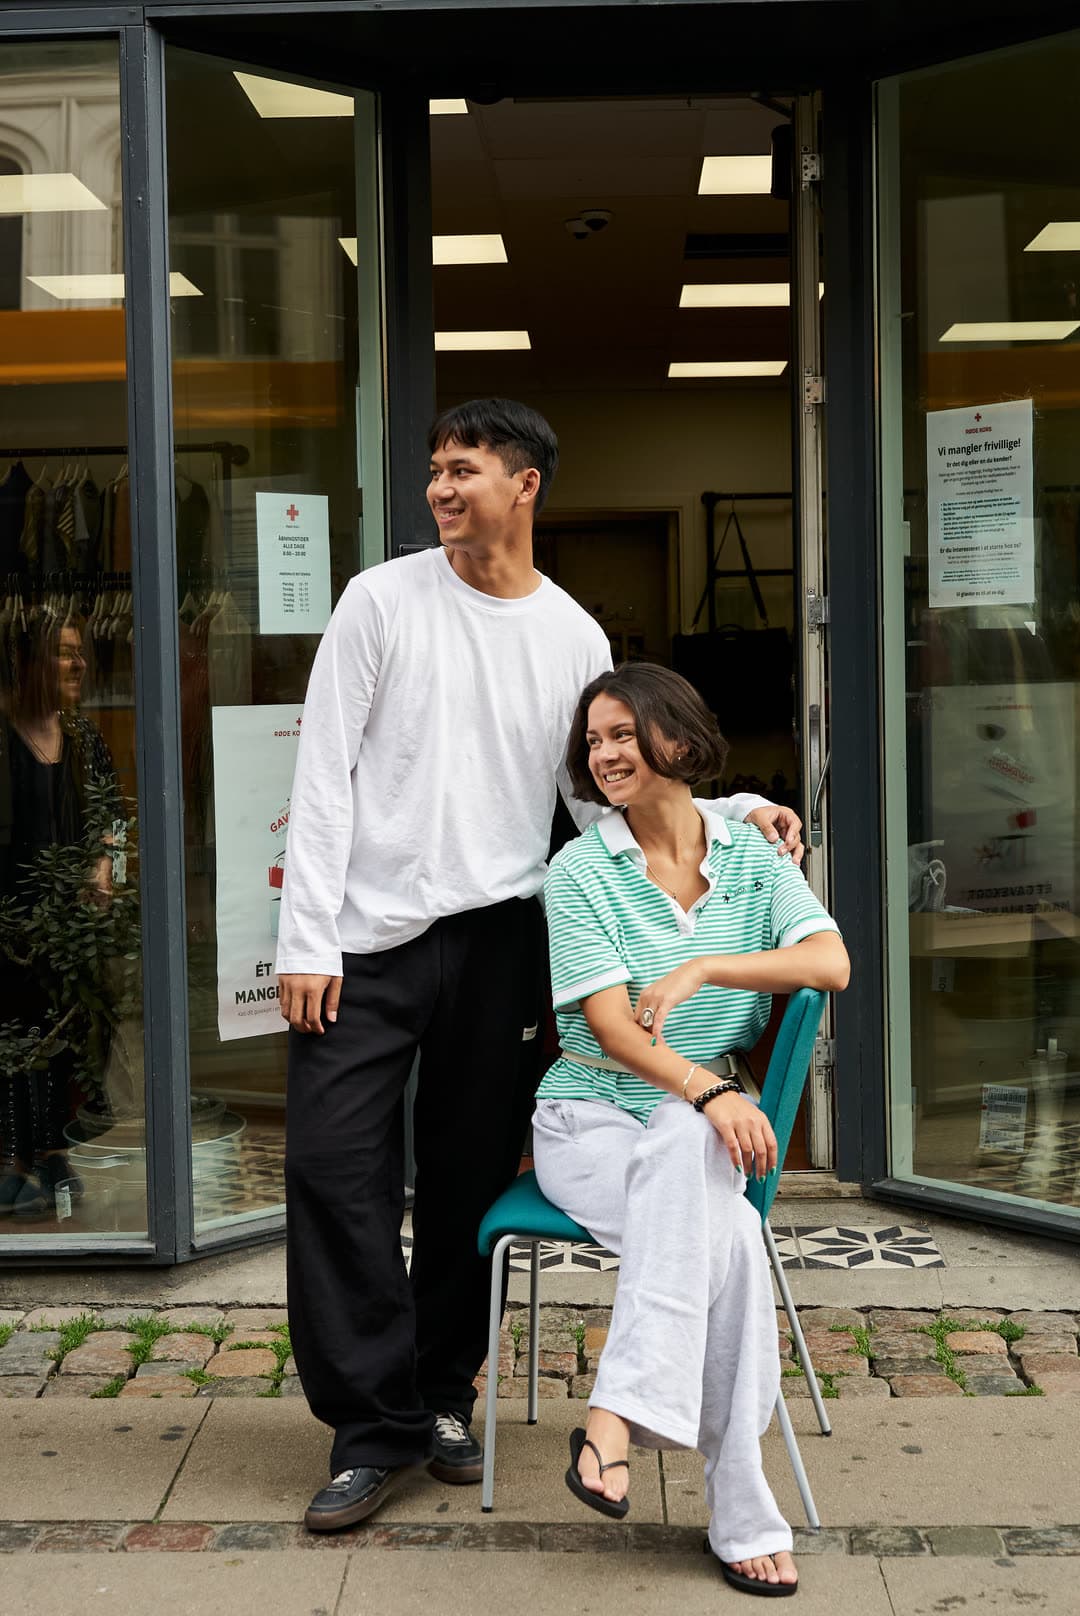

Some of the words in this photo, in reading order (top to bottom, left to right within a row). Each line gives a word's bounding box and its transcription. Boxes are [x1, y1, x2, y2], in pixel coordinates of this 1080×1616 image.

[938, 446, 946, 456] Vi
[948, 443, 982, 456] mangler
[984, 438, 1021, 451] frivillige!
[993, 455, 1012, 463] kender?
[270, 811, 290, 832] GAV
[256, 961, 272, 977] ÉT
